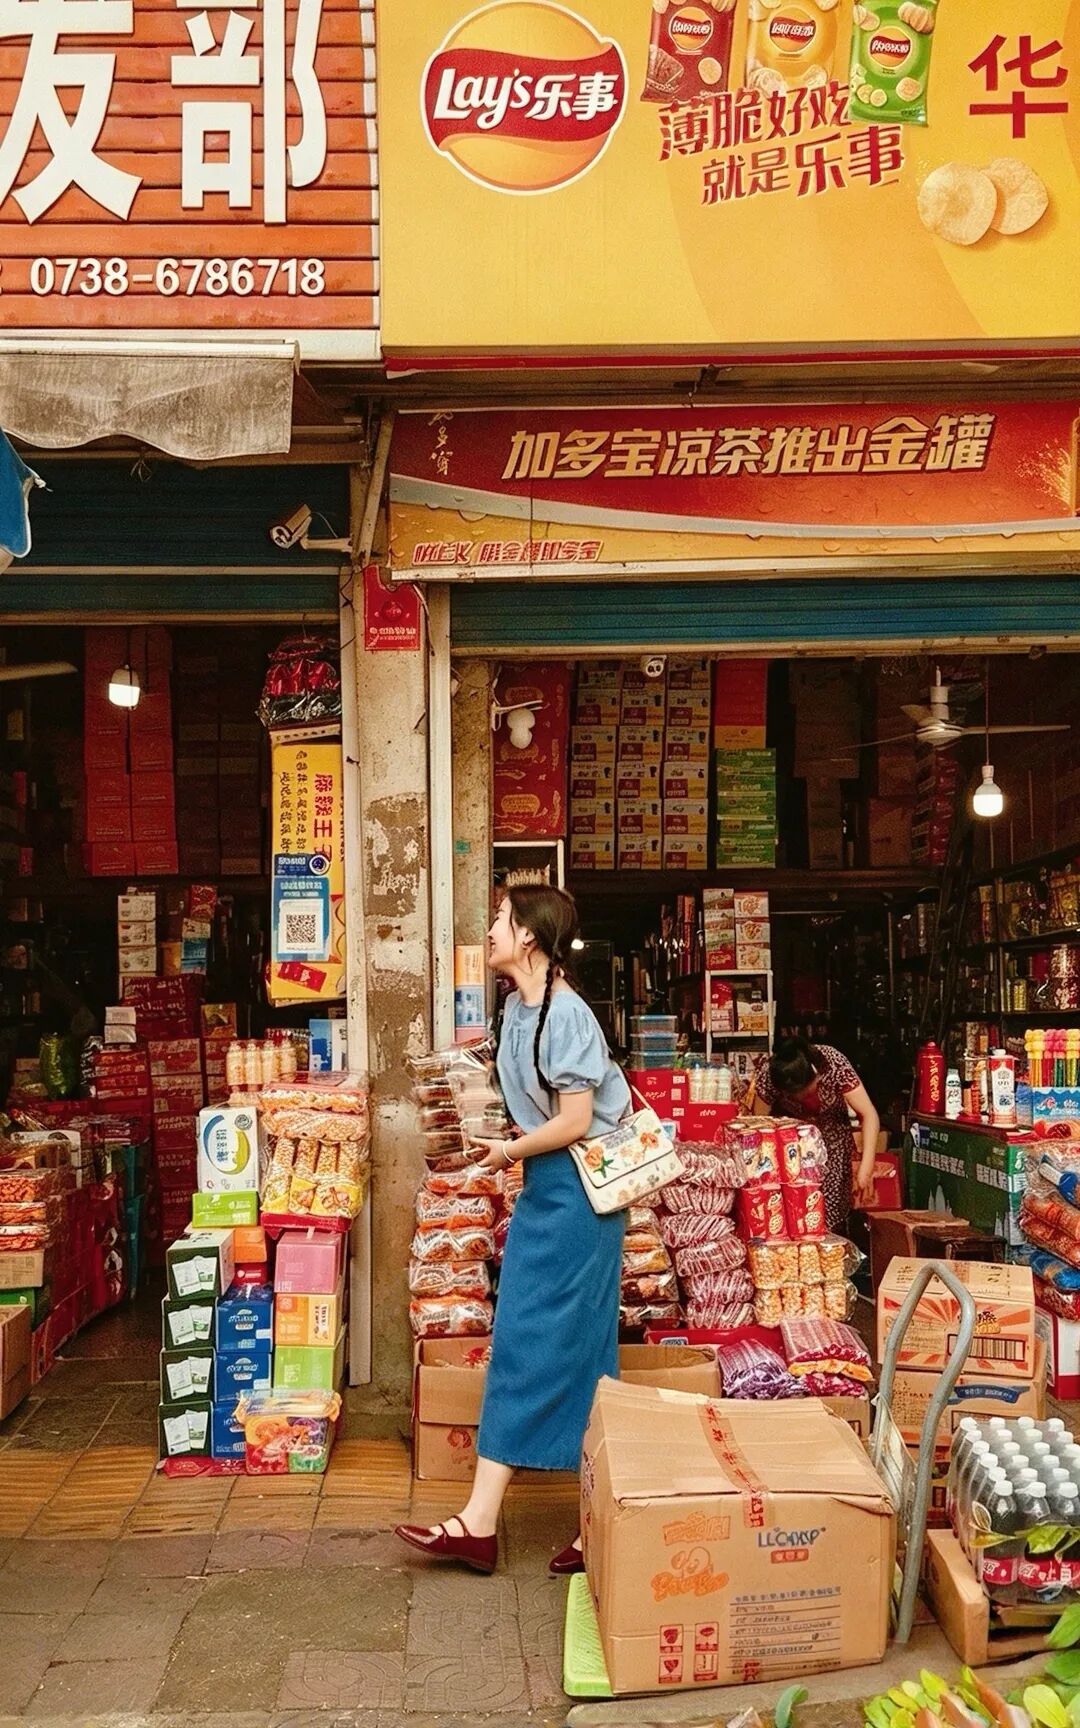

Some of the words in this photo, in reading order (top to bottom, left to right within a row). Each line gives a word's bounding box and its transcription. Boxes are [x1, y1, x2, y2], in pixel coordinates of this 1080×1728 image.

[658, 80, 852, 162] 薄脆好吃
[968, 35, 1069, 139] 华
[701, 125, 904, 206] 就是乐事
[30, 257, 325, 296] 0738-6786718
[501, 414, 996, 480] 加多宝凉茶推出金罐
